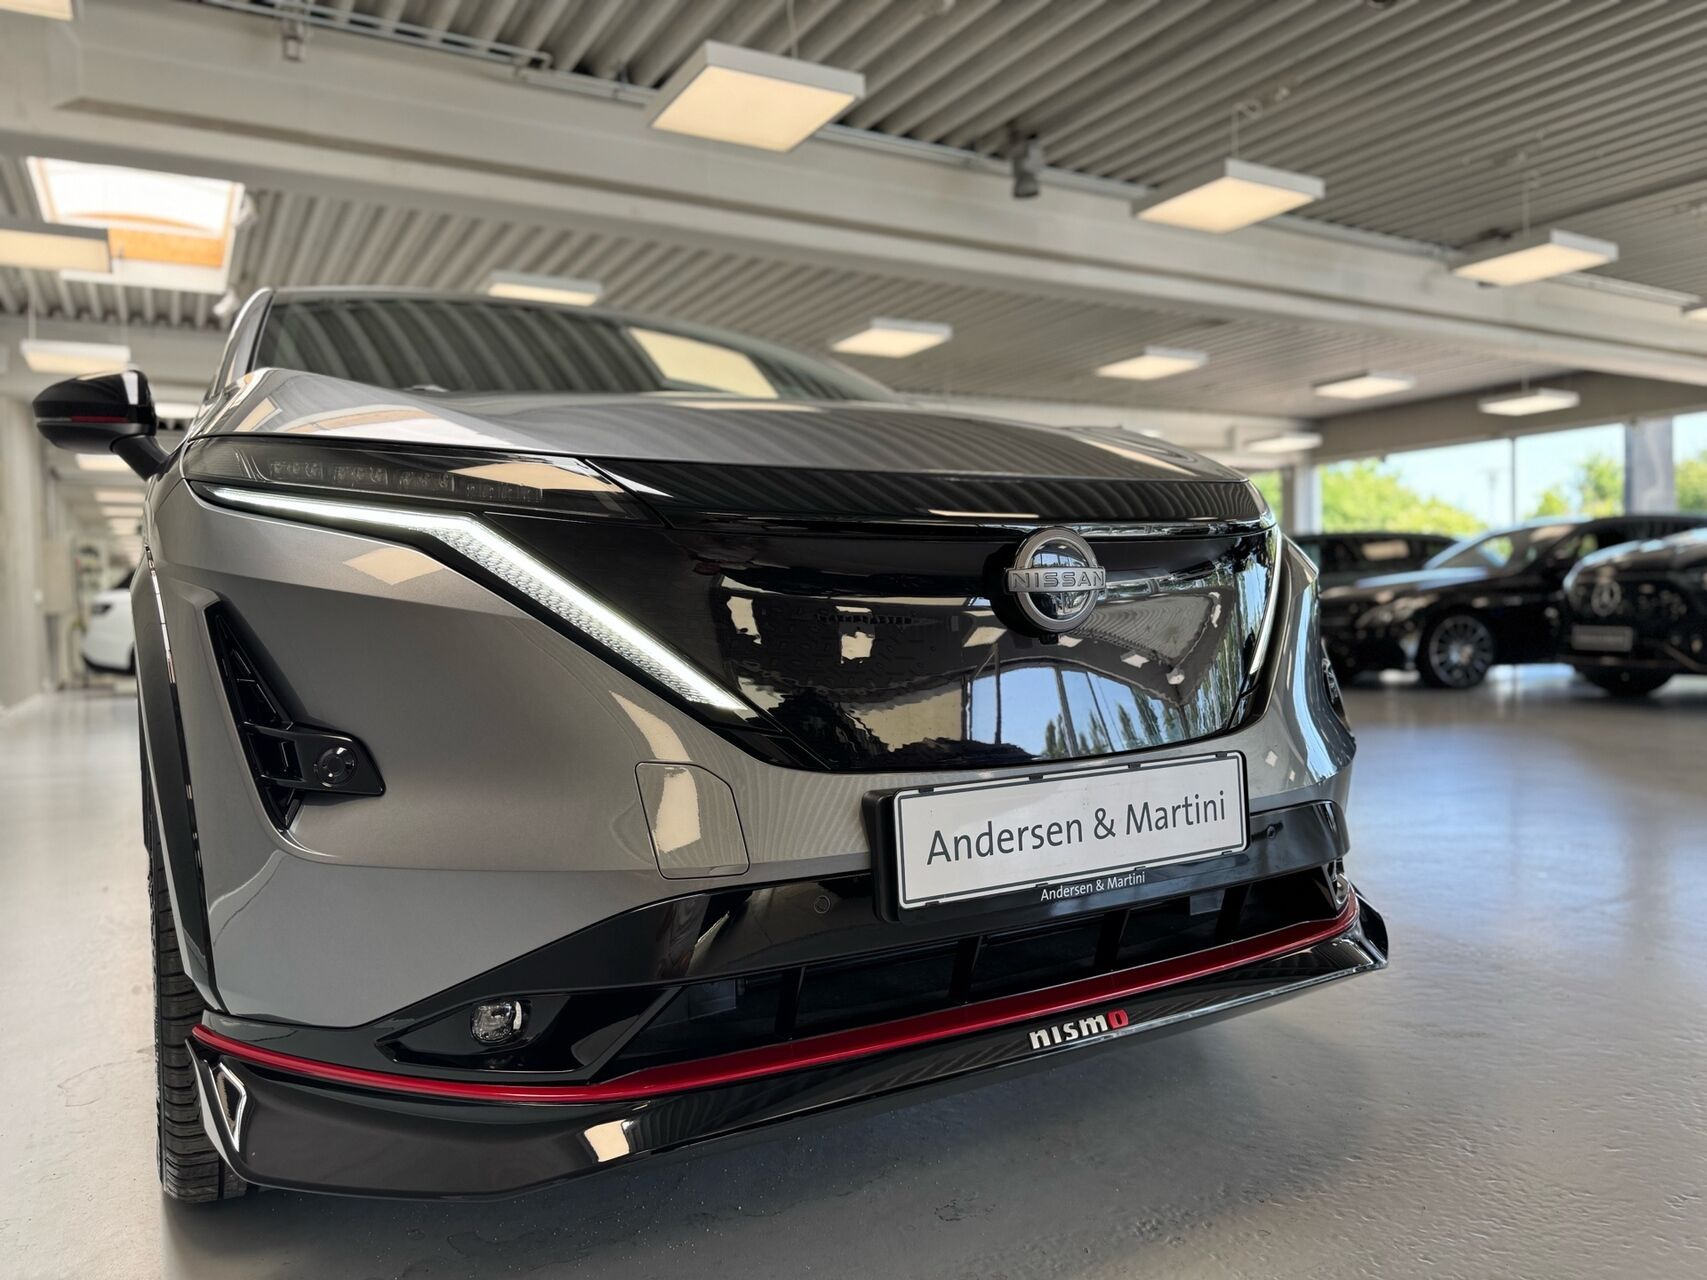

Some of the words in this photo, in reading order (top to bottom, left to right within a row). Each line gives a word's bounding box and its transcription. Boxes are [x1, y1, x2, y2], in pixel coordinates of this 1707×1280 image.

[1012, 570, 1104, 589] NISSAN
[926, 817, 1083, 866] Andersen
[1093, 807, 1117, 840] &
[1125, 790, 1226, 836] Martini
[1040, 882, 1094, 902] Andersen
[1095, 878, 1106, 892] &
[1106, 871, 1146, 890] Martini
